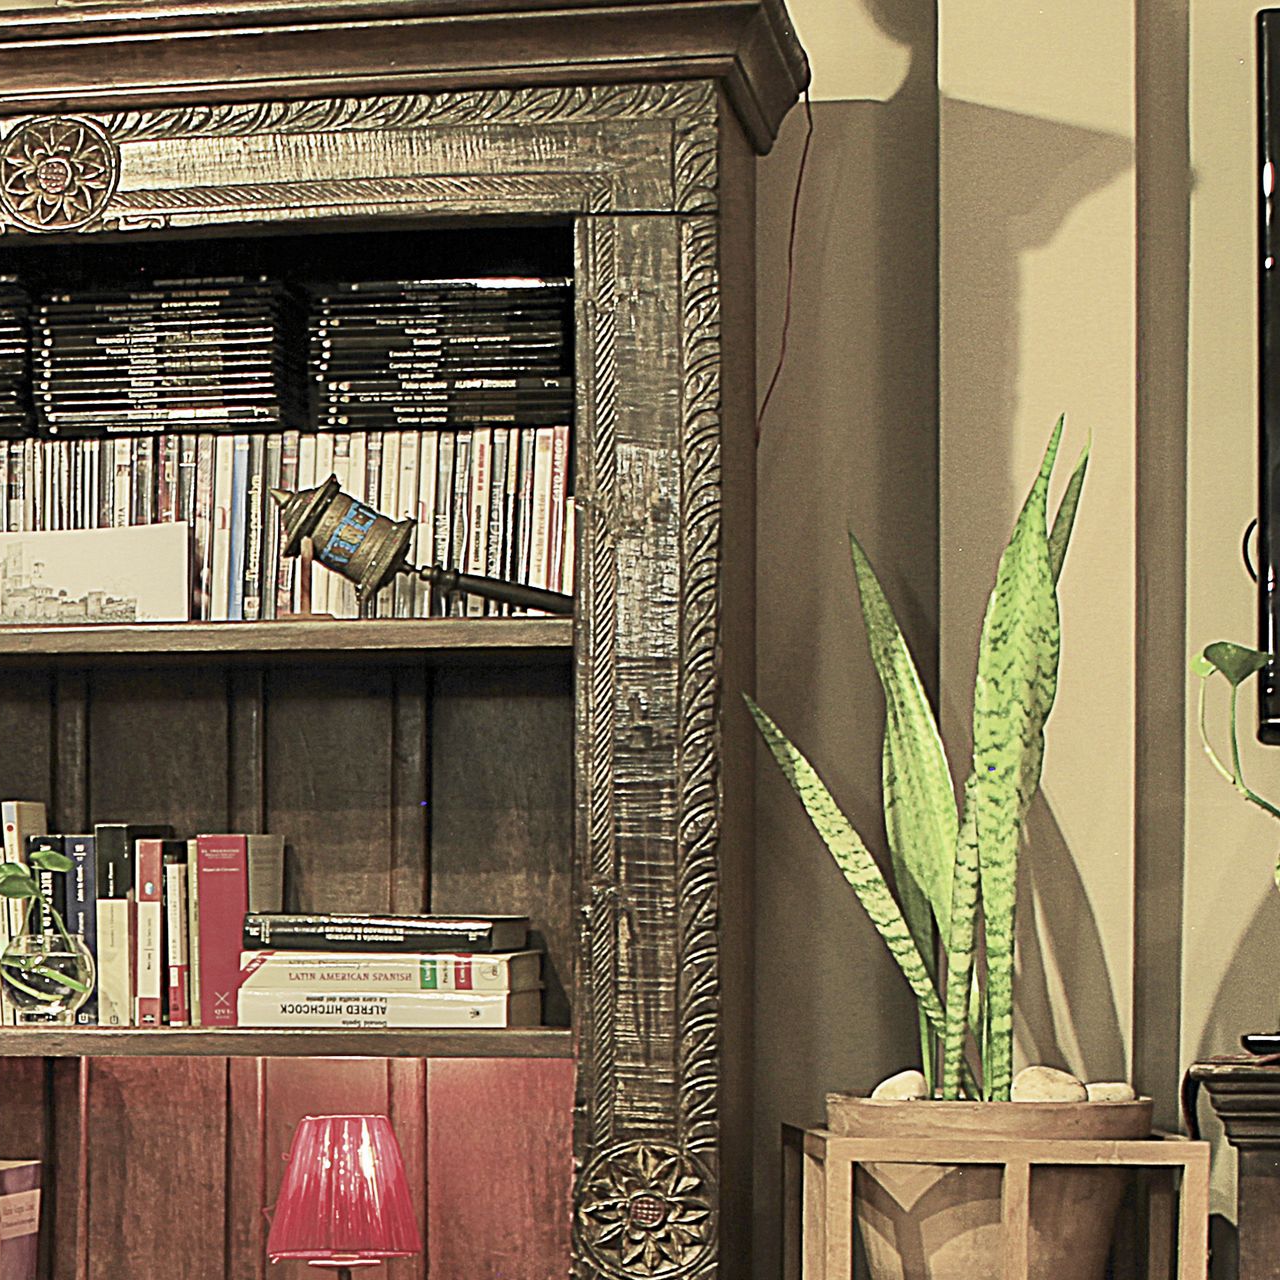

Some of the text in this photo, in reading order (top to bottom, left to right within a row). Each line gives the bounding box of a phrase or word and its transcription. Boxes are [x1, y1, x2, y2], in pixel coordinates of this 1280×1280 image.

[289, 972, 412, 981] LATIN AMERICAN SPANISH
[280, 1004, 387, 1015] ALFRED HITCHCOCK
